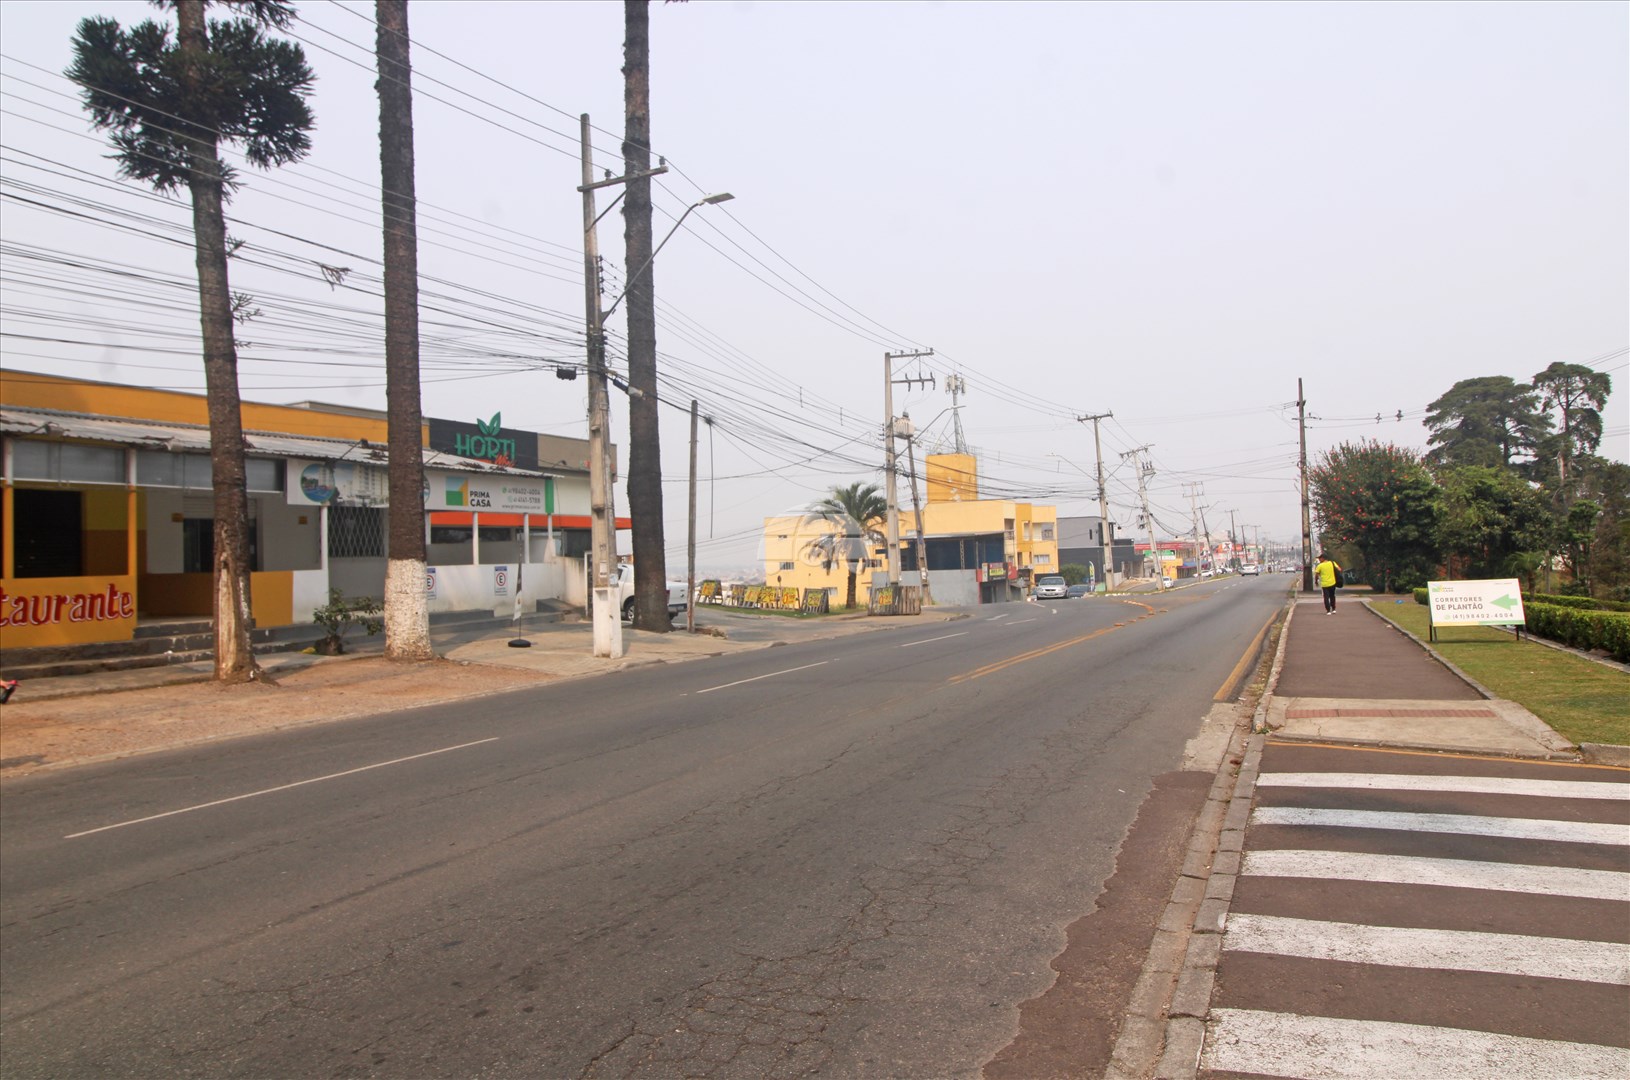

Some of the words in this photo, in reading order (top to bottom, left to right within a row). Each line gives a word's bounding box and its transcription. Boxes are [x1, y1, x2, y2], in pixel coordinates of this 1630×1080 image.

[454, 433, 515, 460] HORTI
[469, 490, 490, 498] PRIMA
[469, 499, 491, 507] CASA
